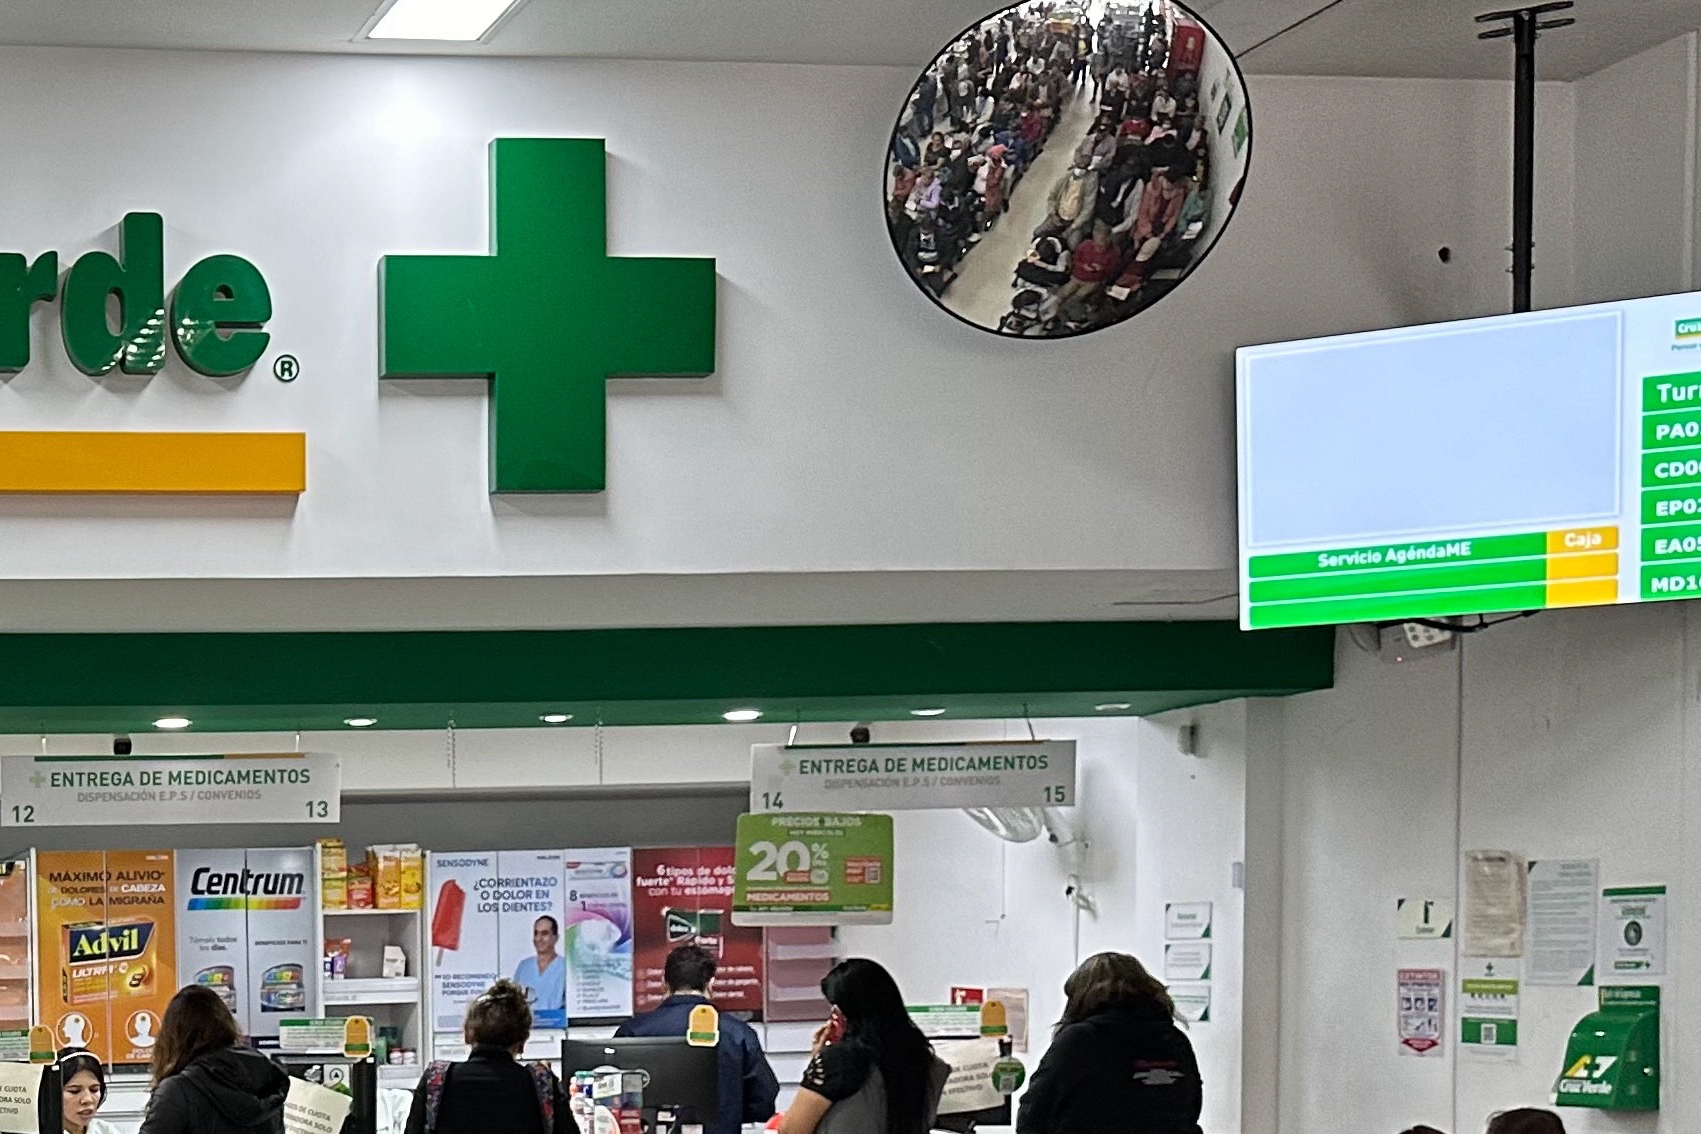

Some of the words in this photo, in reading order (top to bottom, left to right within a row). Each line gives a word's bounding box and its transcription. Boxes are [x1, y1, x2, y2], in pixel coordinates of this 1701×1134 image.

[1656, 383, 1701, 404] Tur
[1656, 421, 1701, 441] PA0
[1654, 461, 1701, 479] CD0
[1564, 531, 1602, 549] Caja
[1318, 550, 1382, 568] Servicio
[1385, 541, 1472, 563] AgéndaME
[1651, 576, 1701, 593] MD1
[799, 758, 879, 775] ENTREGA
[885, 757, 906, 772] DE
[911, 754, 1049, 772] MEDICAMENTOS
[51, 771, 134, 788] ENTREGA
[140, 771, 162, 786] DE
[168, 769, 310, 786] MEDICAMENTOS
[77, 789, 156, 802] DISPENSACIÓN
[198, 788, 262, 800] CONVENIOS
[762, 792, 784, 809] 14
[1044, 786, 1066, 803] 15
[11, 805, 35, 823] 12
[305, 800, 329, 818] 13
[436, 858, 489, 868] SENSODYNE
[656, 864, 666, 876] 6
[49, 870, 111, 882] MÁXIMO
[191, 867, 304, 896] Centrum
[473, 876, 558, 891] ¿CORRIENTAZO
[121, 884, 166, 893] CABEZA
[480, 890, 490, 900] O
[493, 890, 532, 900] DOLOR
[535, 889, 550, 899] EN
[569, 890, 577, 902] 8
[89, 898, 104, 906] LA
[109, 895, 165, 906] MIGRAÑA
[477, 902, 499, 913] LOS
[502, 901, 553, 912] DIENTES?
[73, 928, 139, 957] Advil
[4, 1085, 27, 1093] CUOTA
[14, 1097, 32, 1105] SOLO
